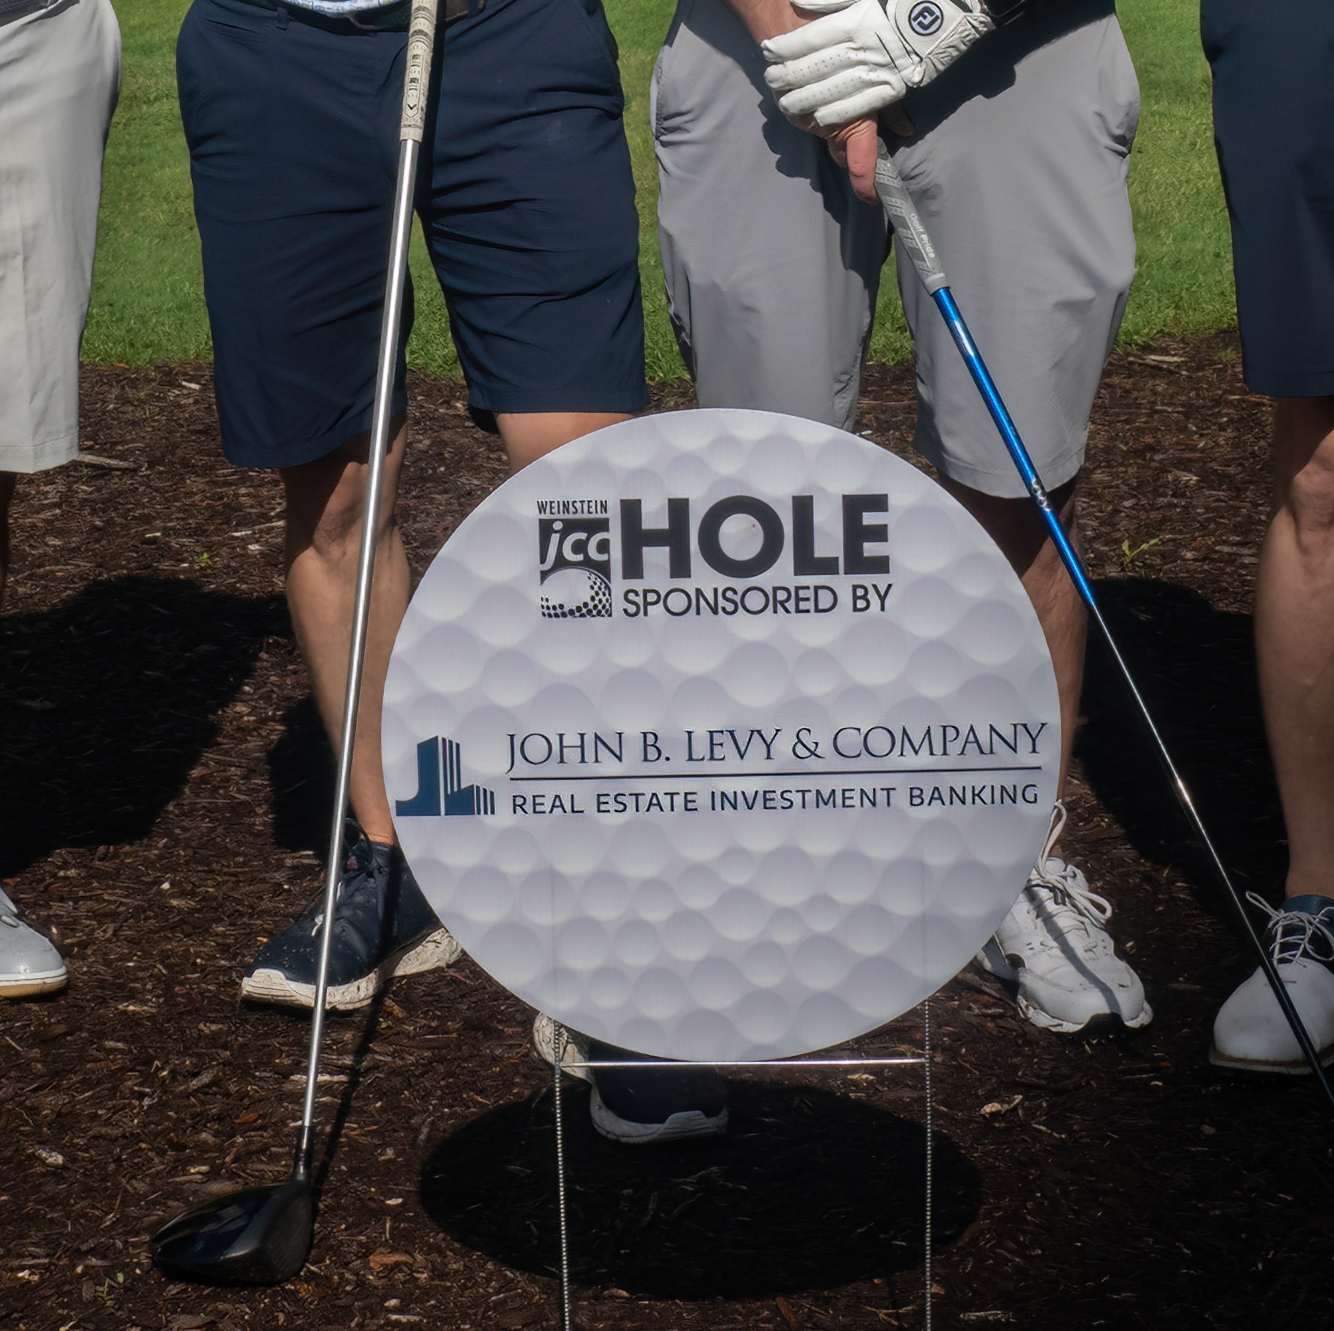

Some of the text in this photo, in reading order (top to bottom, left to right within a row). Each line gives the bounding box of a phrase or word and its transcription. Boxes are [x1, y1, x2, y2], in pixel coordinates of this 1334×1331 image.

[920, 234, 935, 258] Pride
[537, 500, 608, 515] WEINSTEIN
[539, 520, 610, 571] jcc
[620, 494, 890, 580] HOLE
[623, 583, 893, 617] SPONSORED BY
[506, 722, 1048, 774] JOHN B. LEVY & COMPANY
[513, 783, 1039, 815] REAL ESTATE INVESTMENT BANKING
